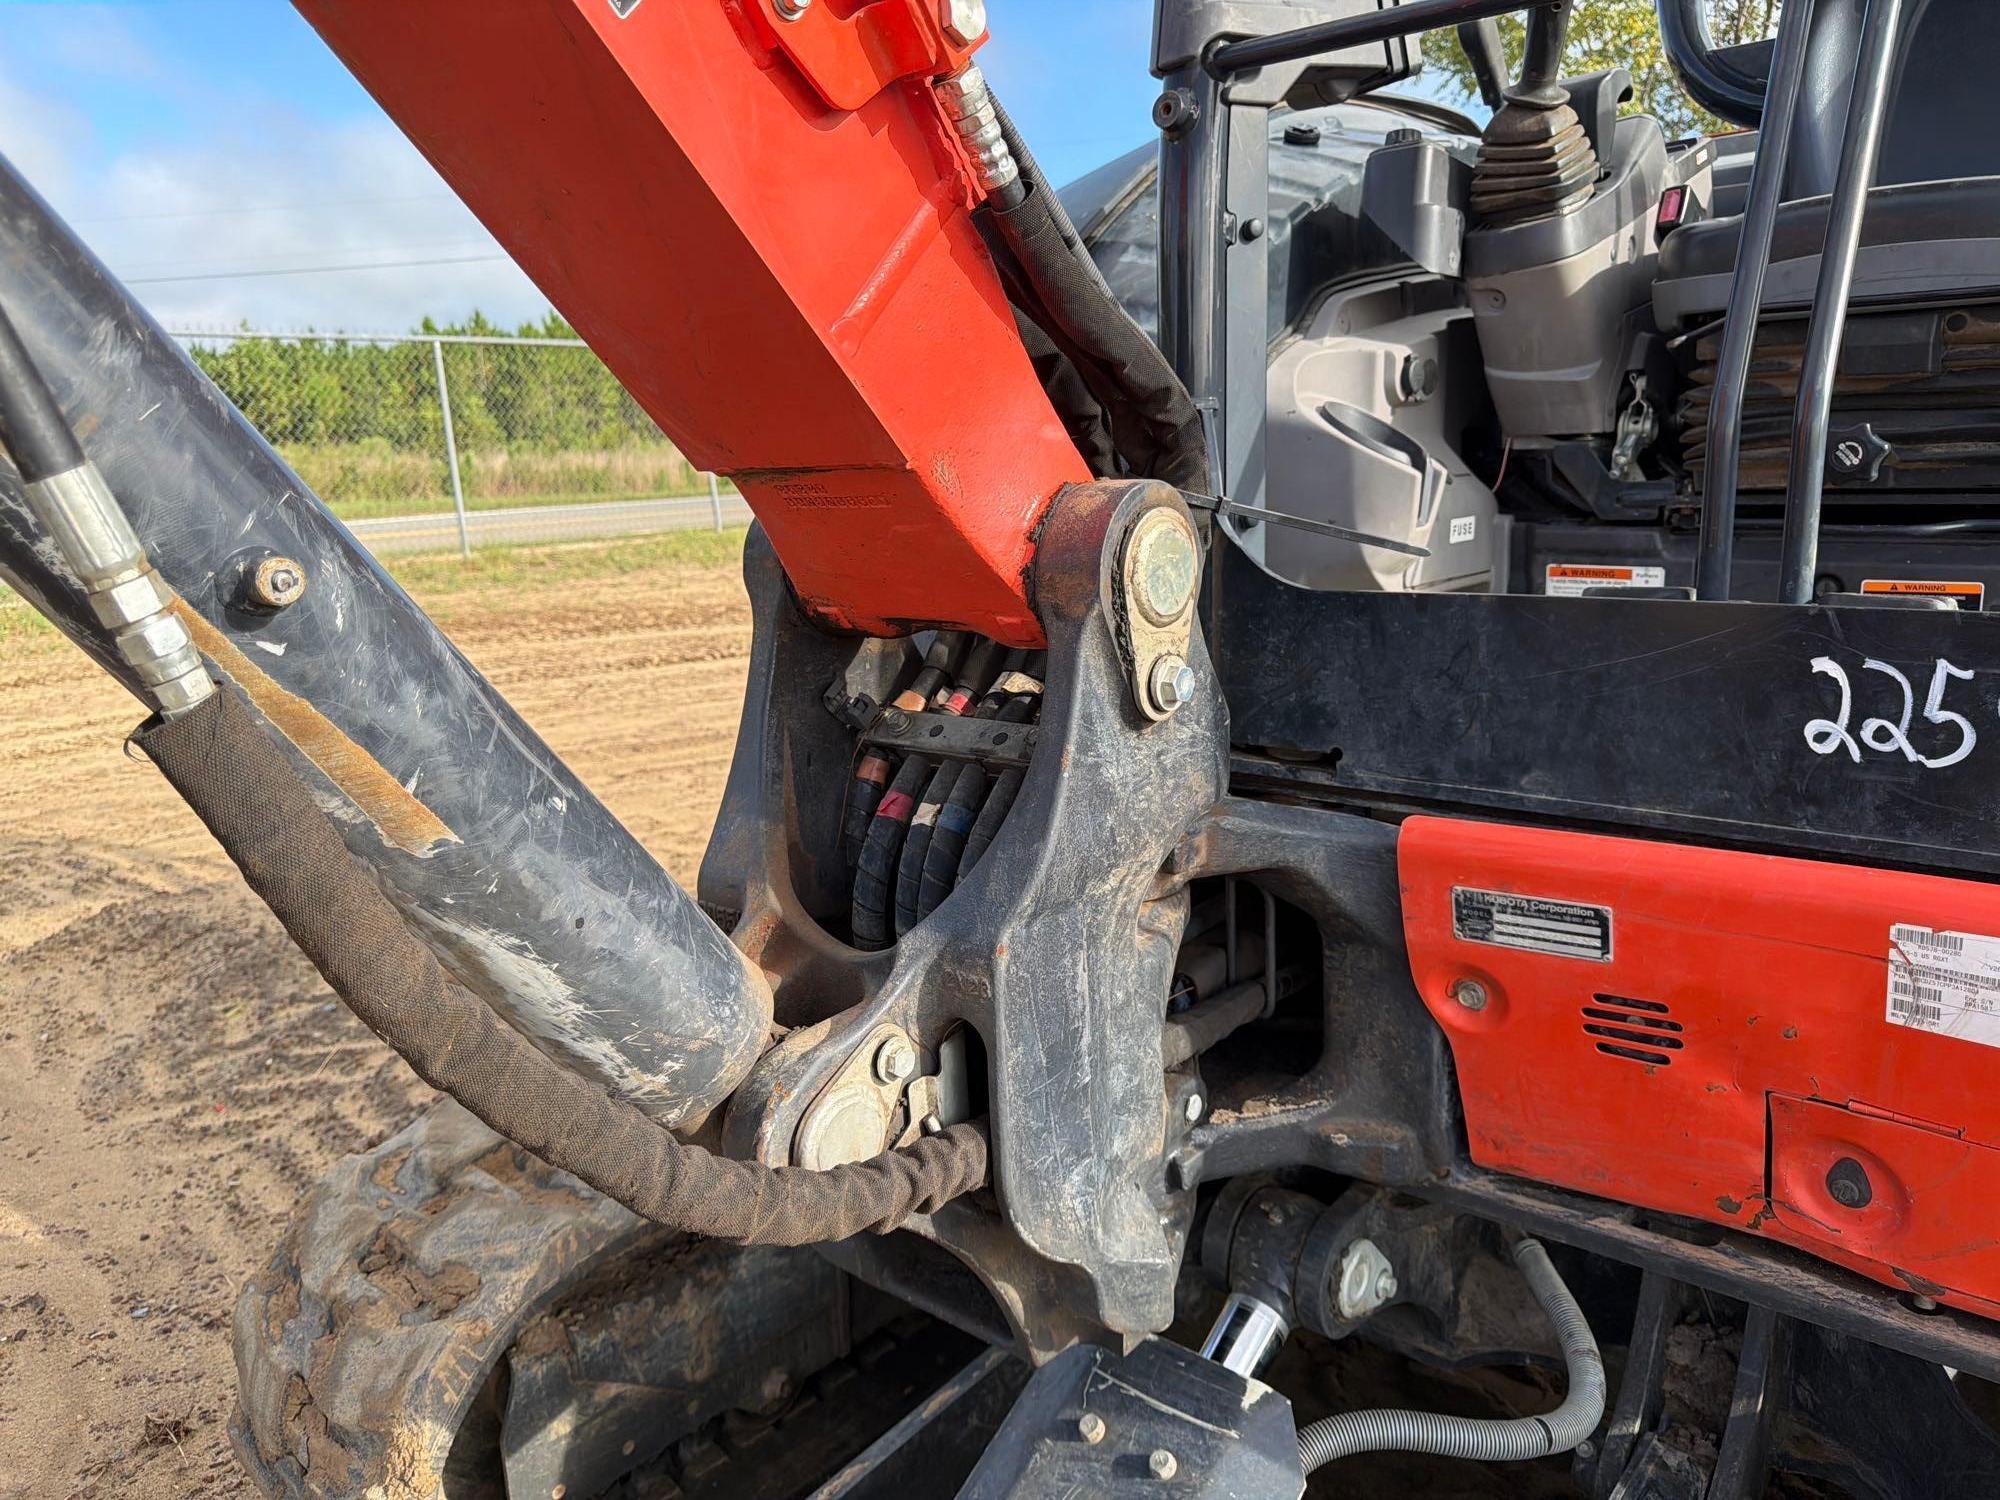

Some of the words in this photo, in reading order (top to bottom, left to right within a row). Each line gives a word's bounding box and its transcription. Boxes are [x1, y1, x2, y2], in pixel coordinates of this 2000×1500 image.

[1452, 522, 1473, 536] FUSE
[1571, 569, 1617, 578] WARNING
[1904, 584, 1947, 592] WARNING
[1804, 656, 1977, 769] 225
[1484, 894, 1528, 908] KUBOTA
[1530, 901, 1594, 917] Corporation
